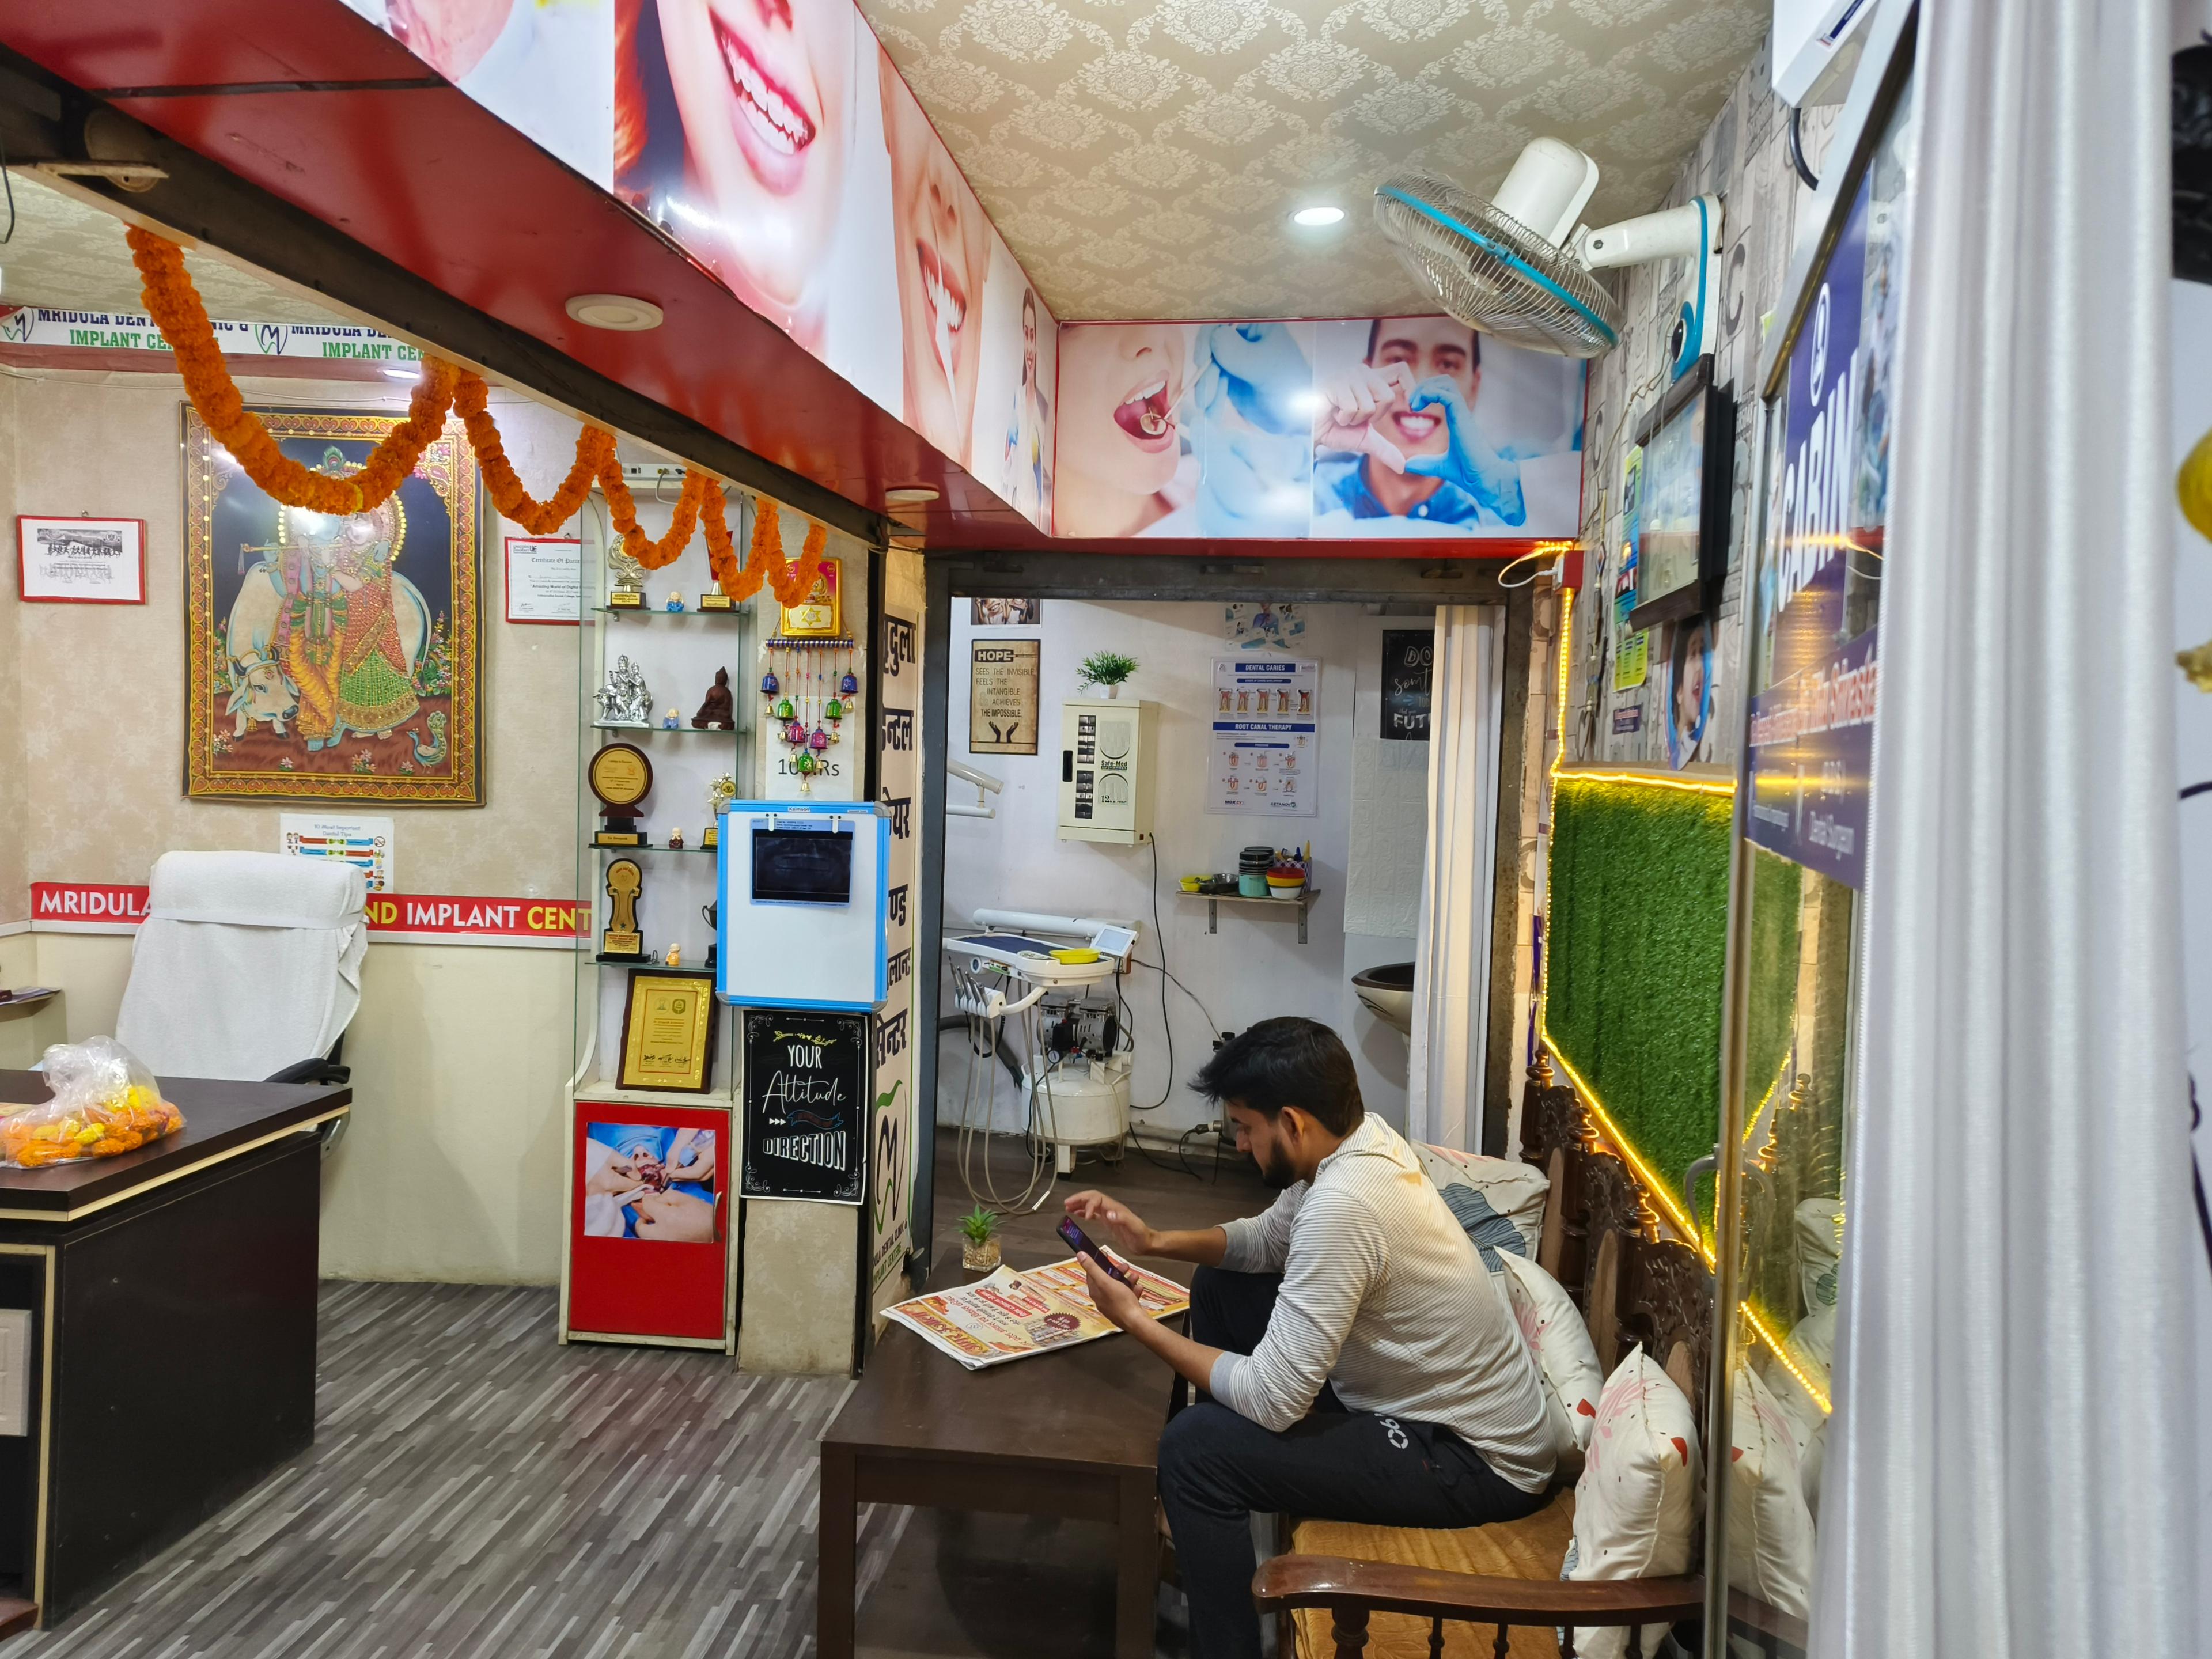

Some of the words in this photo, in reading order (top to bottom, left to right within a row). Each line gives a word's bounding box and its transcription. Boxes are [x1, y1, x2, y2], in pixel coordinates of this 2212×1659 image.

[115, 315, 153, 327] DEN
[69, 329, 141, 347] IMPLANT
[323, 342, 392, 360] IMPLANT
[1778, 347, 1859, 612] CABIN
[978, 650, 1012, 661] HOPE
[976, 677, 993, 685] FEELS
[997, 677, 1007, 685] THE
[987, 688, 1020, 696] INTANGIBLE
[992, 698, 1021, 706] ACHIEVES
[981, 709, 990, 717] THE
[1393, 713, 1431, 730] FUT
[1101, 795, 1109, 803] 12
[40, 890, 151, 916] MRIDULA
[364, 902, 397, 924] ND
[407, 902, 520, 929] IMPLANT
[527, 906, 591, 931] CENT
[787, 1044, 822, 1069] YOUR
[762, 1070, 846, 1114] Attitude
[763, 1131, 846, 1171] DIRECTION
[881, 1233, 894, 1257] DENTAL
[894, 1221, 905, 1242] CLINIC
[873, 1259, 887, 1285] MPLANT
[912, 1311, 948, 1334] उजाला
[945, 1333, 983, 1351] अमर
